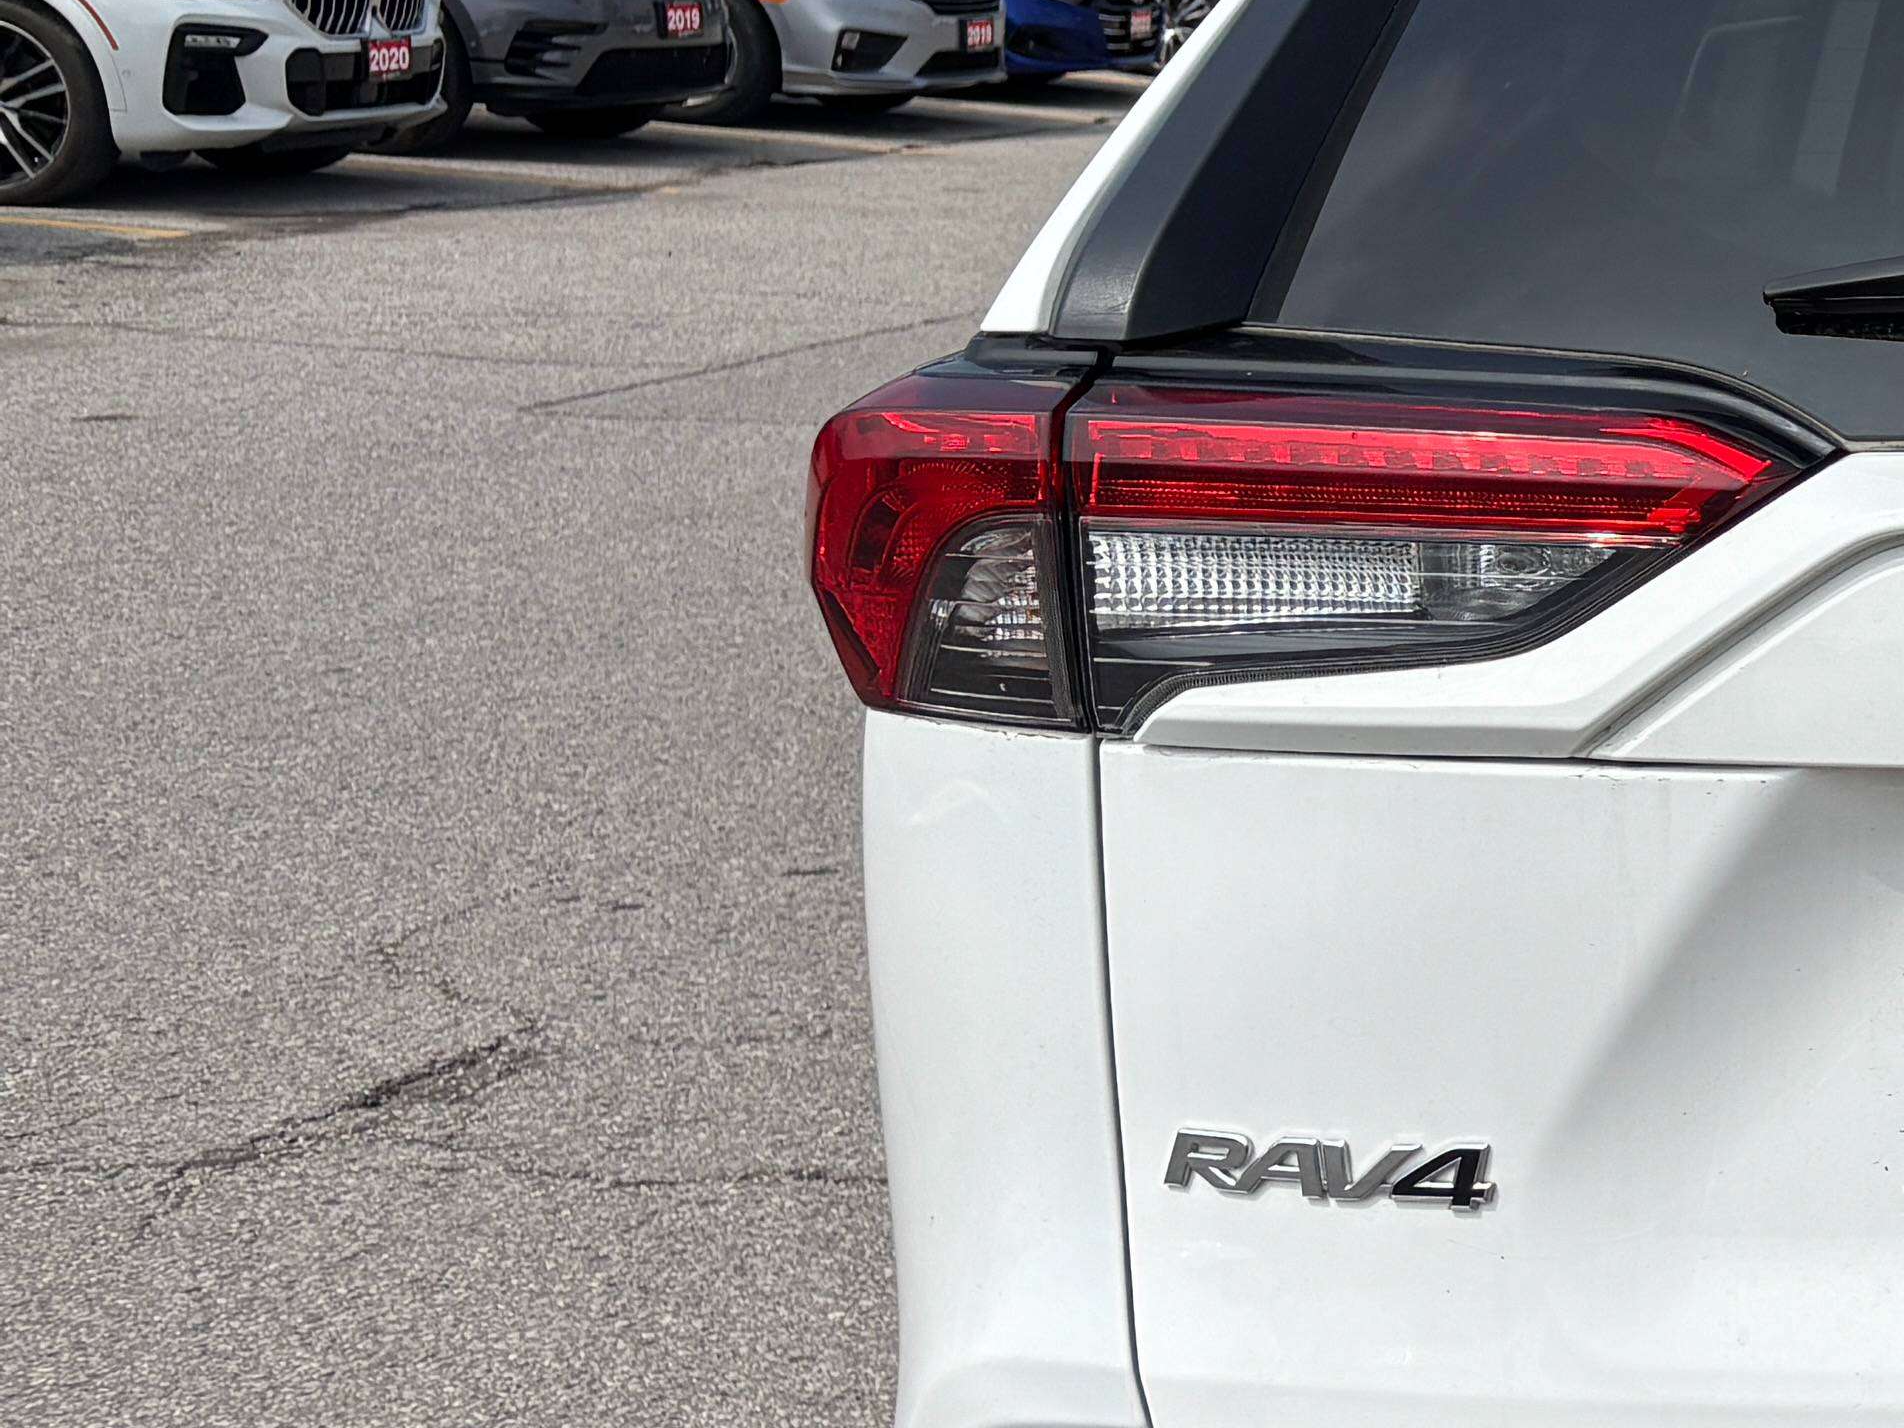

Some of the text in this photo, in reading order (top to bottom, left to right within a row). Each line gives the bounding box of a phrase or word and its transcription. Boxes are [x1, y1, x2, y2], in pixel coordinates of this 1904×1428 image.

[667, 8, 700, 31] 2019
[369, 46, 410, 72] 2020
[1164, 1127, 1498, 1213] RAV4
